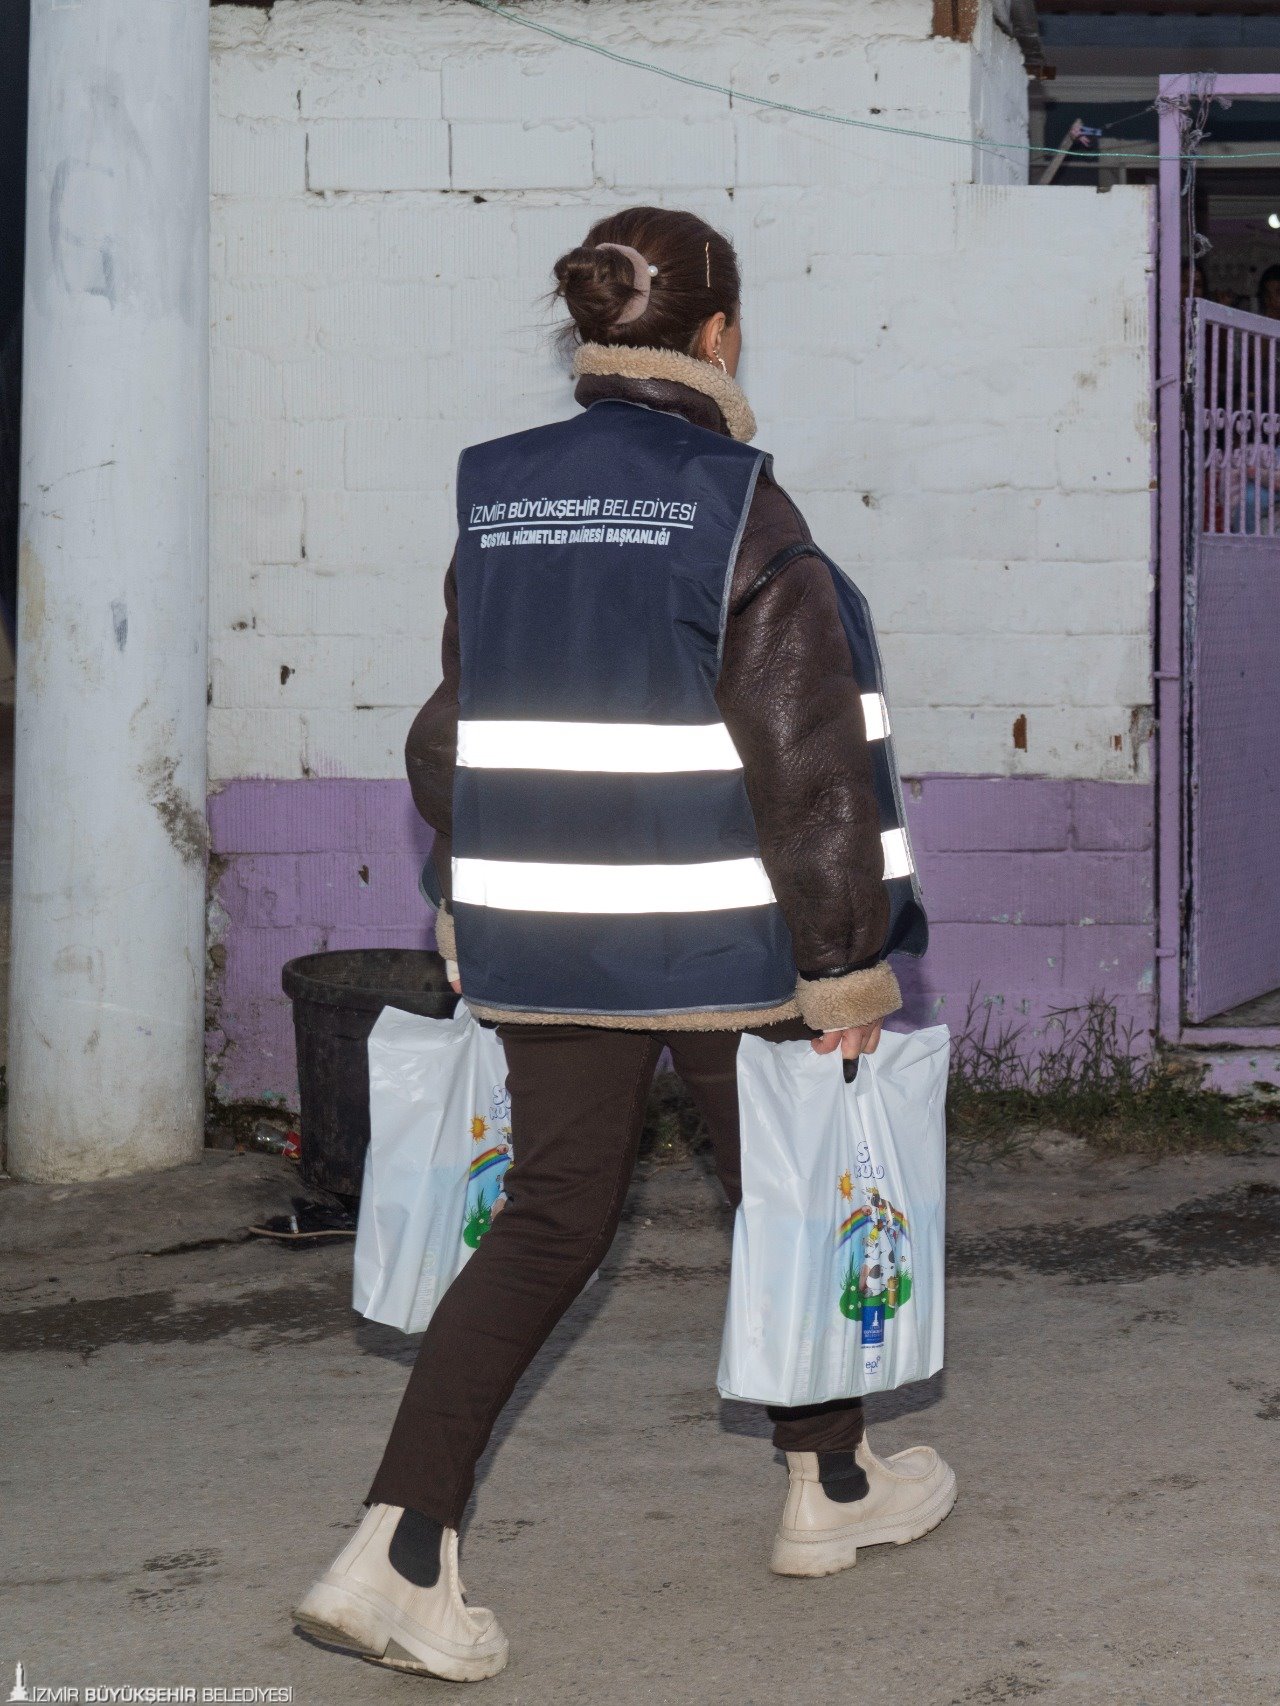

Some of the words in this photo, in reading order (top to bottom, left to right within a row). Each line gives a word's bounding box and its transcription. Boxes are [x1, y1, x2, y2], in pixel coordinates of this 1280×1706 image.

[470, 501, 506, 524] İZMİR
[508, 496, 600, 520] BÜYÜKŞEHİR
[602, 498, 698, 522] BELEDİYESİ
[481, 529, 511, 549] SOSYAL
[512, 527, 568, 545] HİZMETLER
[568, 525, 605, 544] DAİRESİ
[606, 527, 670, 547] BAŞKANLIĞI
